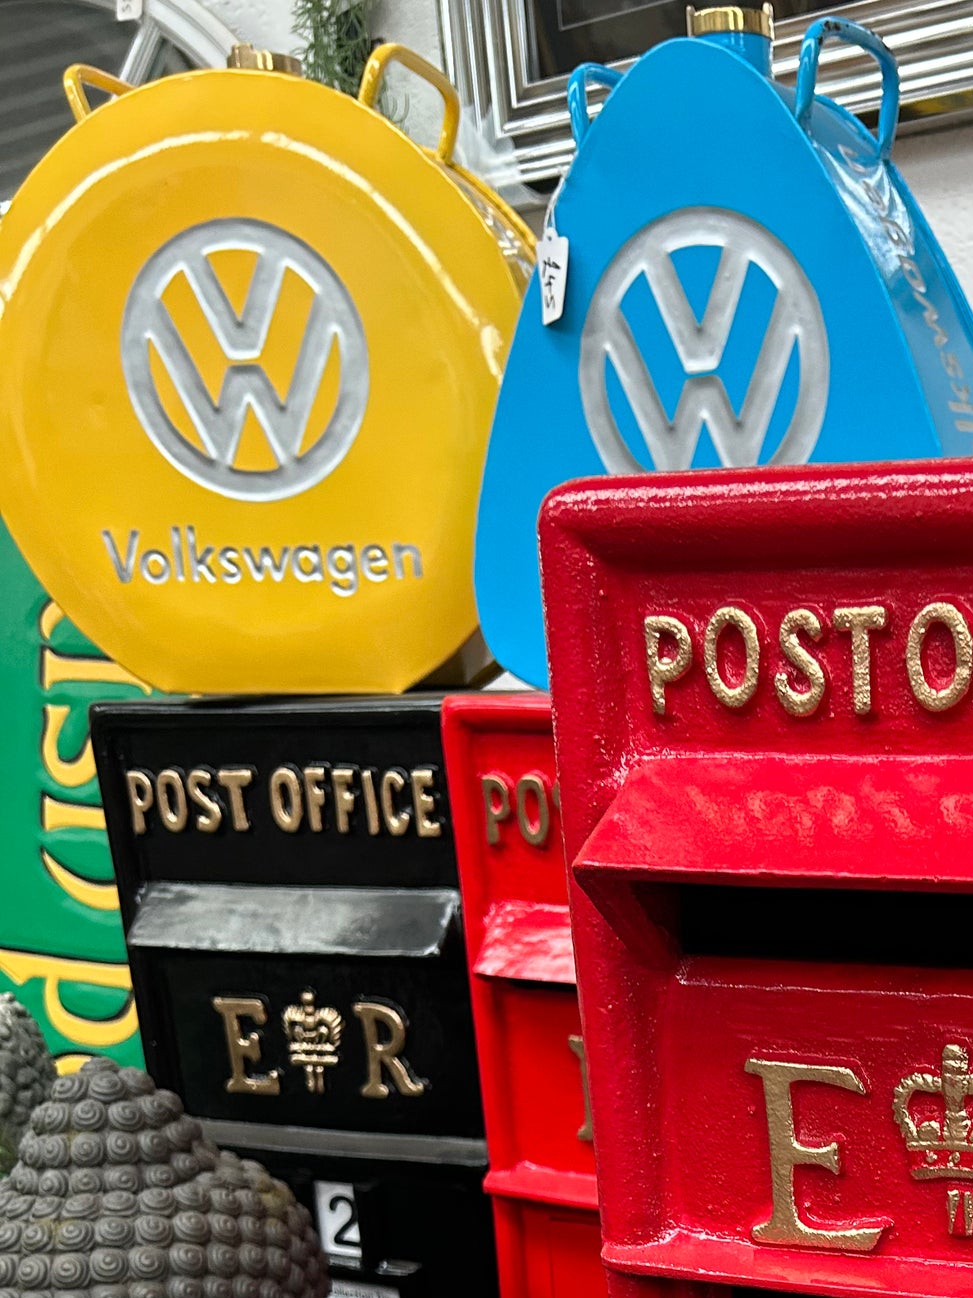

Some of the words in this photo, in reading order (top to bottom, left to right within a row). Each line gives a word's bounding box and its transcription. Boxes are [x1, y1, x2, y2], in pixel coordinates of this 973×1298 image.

[102, 525, 423, 597] Volkswagen
[126, 768, 253, 835] POST
[270, 766, 442, 838] OFFICE
[481, 773, 560, 846] PO
[213, 997, 281, 1095] E
[353, 1001, 425, 1099] R
[744, 1058, 883, 1251] E
[329, 1195, 361, 1247] 2
